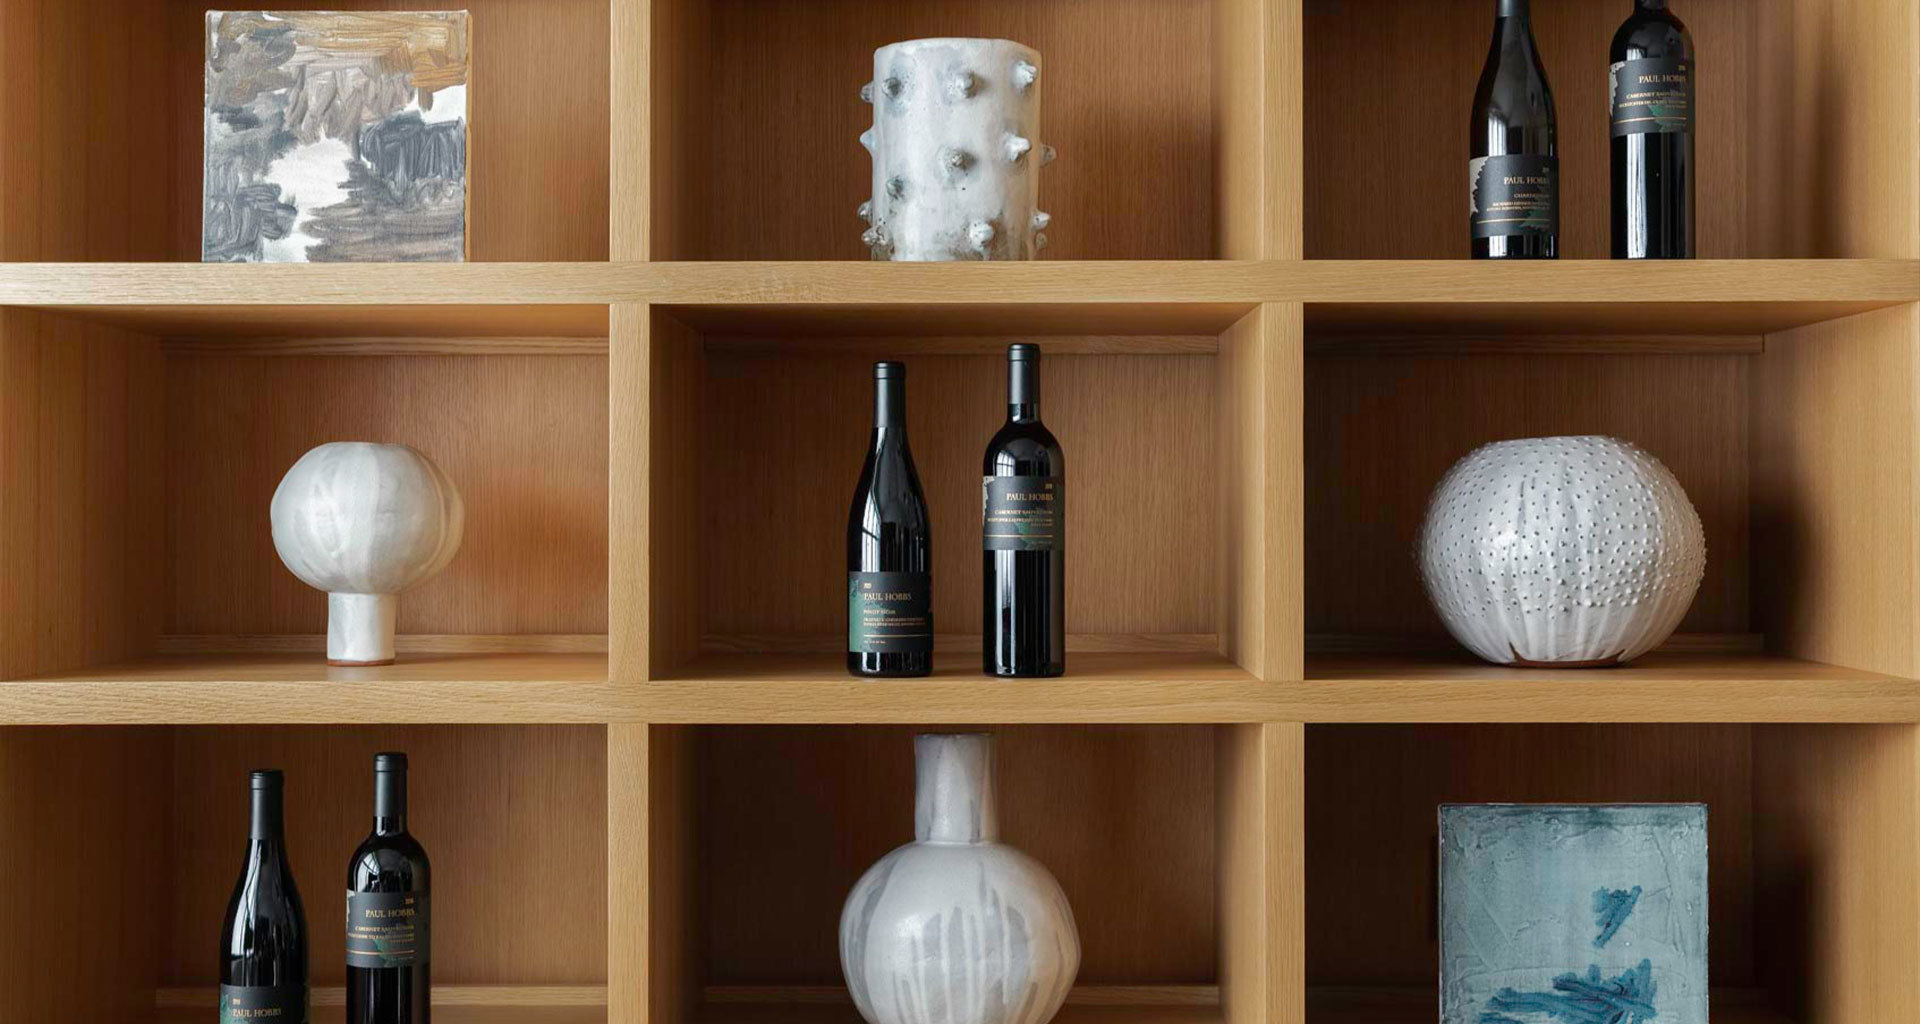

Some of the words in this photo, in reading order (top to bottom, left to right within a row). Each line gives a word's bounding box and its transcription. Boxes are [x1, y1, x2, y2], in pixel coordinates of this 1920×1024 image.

[1638, 75, 1660, 84] PAUL
[1504, 176, 1525, 185] PAUL
[1006, 493, 1027, 501] PAUL
[1029, 493, 1054, 501] HOBBS
[864, 592, 883, 601] PAUL
[885, 592, 912, 601] HOBBS
[365, 909, 385, 918] PAUL
[388, 908, 415, 917] HOBBS
[232, 1008, 252, 1017] PAUL
